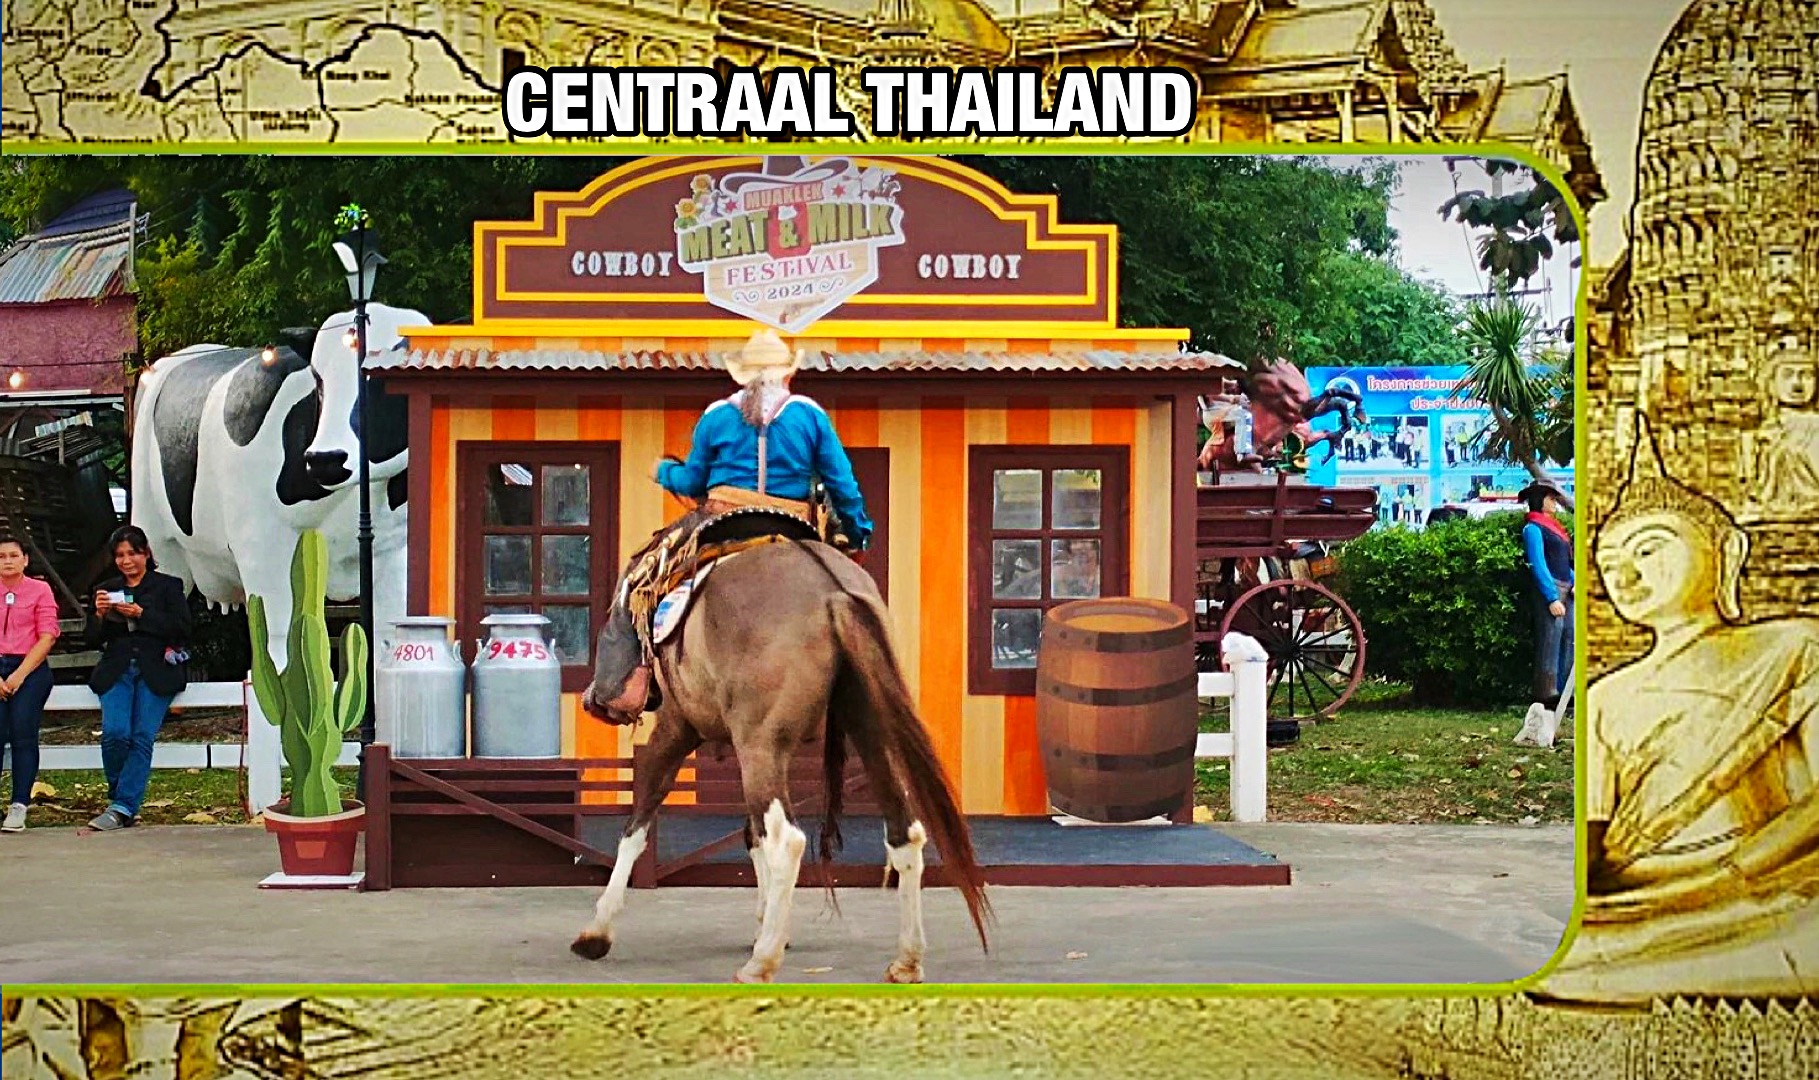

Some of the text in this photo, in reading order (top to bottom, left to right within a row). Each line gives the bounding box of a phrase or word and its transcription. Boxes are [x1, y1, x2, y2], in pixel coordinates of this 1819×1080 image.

[680, 203, 895, 262] MEAT & MILK
[572, 250, 673, 277] COWBOY
[726, 252, 852, 285] FESTIVAL
[918, 253, 1021, 279] COWBOY
[767, 283, 813, 300] 2024
[488, 640, 548, 661] 9475
